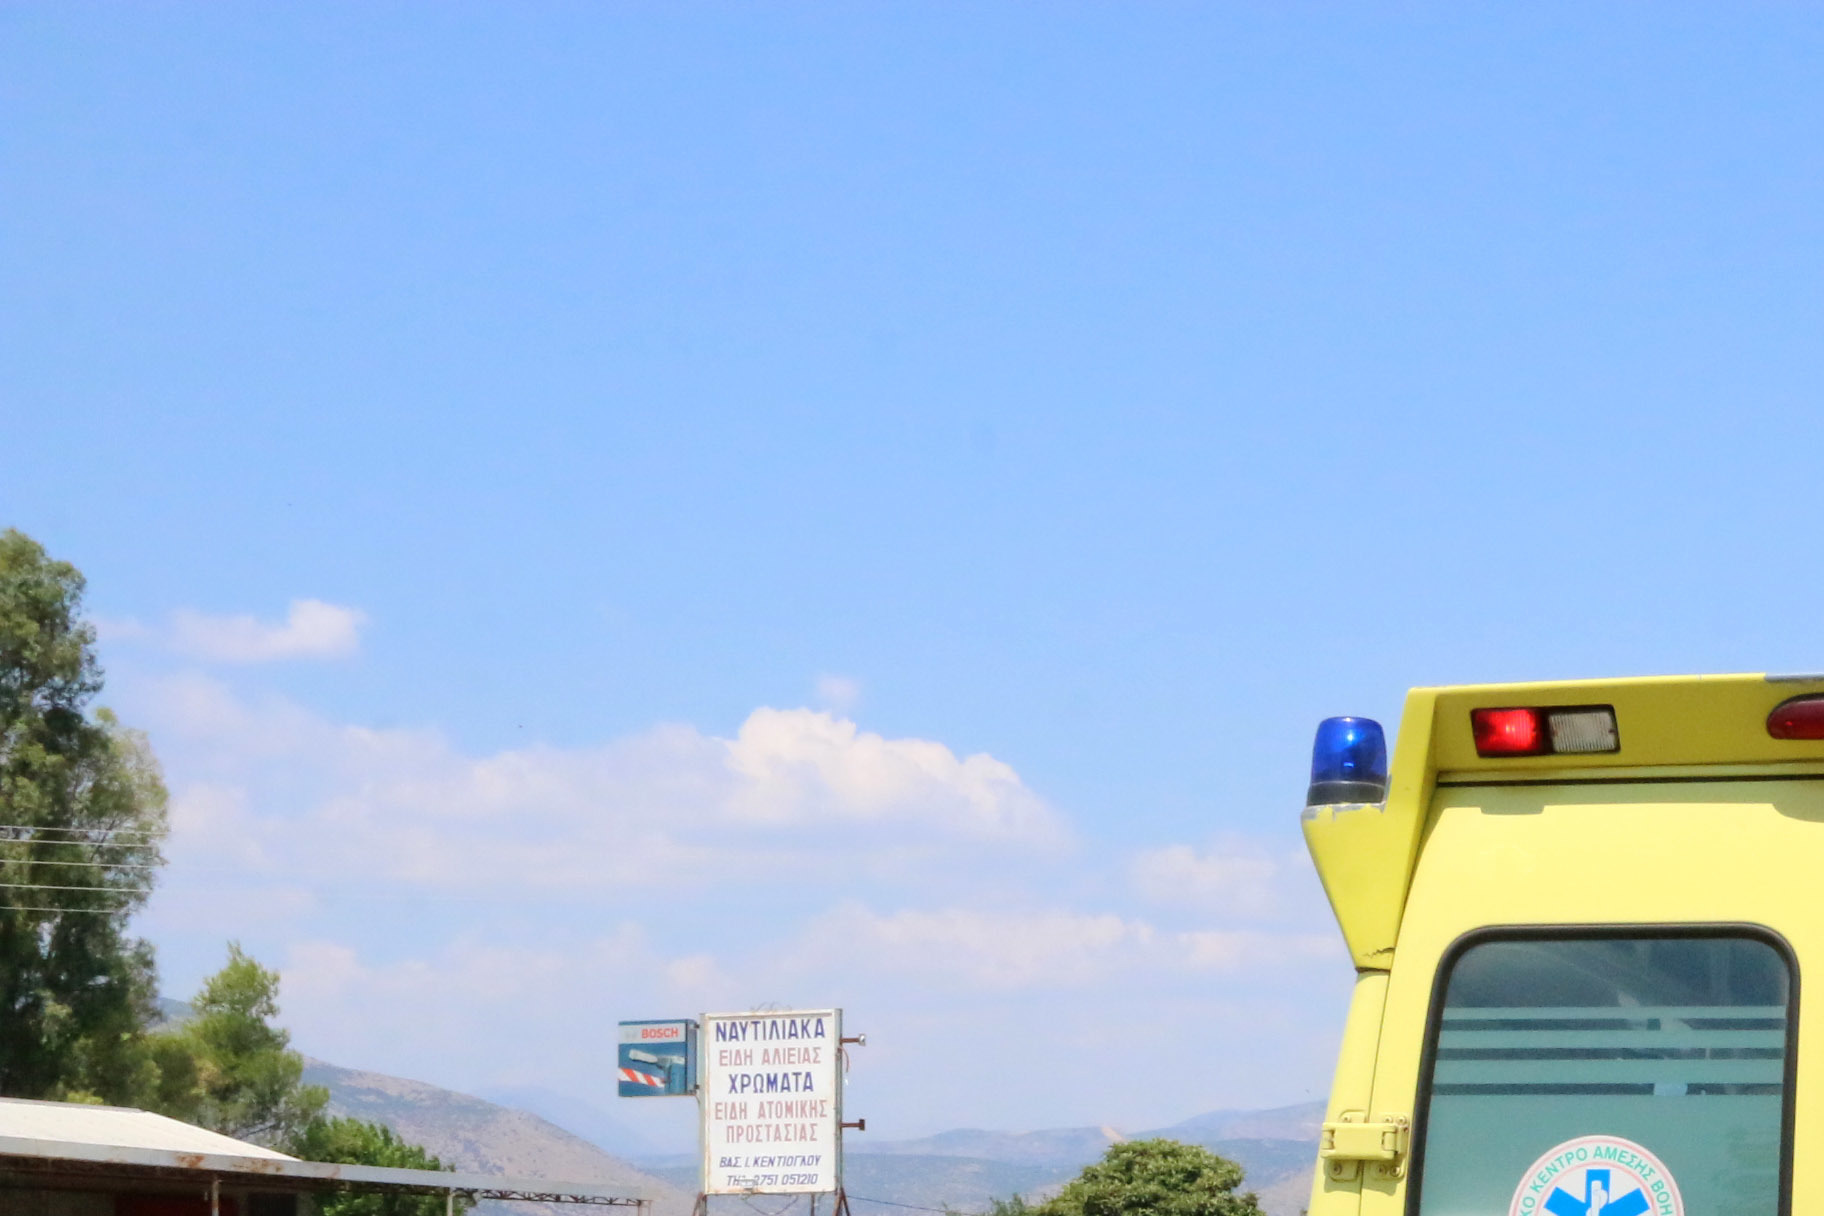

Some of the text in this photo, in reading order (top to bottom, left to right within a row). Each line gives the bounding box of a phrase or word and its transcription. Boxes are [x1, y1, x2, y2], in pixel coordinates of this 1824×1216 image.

[641, 1028, 679, 1039] BOSCH
[715, 1018, 825, 1042] ΝΑΥΤΙΛΙΑΚΑ
[719, 1047, 822, 1067] ΕΙΔΗ ΑΛΙΕΙΑΣ
[728, 1071, 814, 1094] ΧΡΩΜΑΤΑ
[714, 1099, 828, 1120] ΕΙΔΗ ΑΤΟΜΙΚΗΣ
[726, 1123, 818, 1143] ΠΡΟΣΤΑΣΙΑΣ
[1530, 1148, 1588, 1194] ΚΕΝΤΡΟ
[1593, 1145, 1656, 1181] ΑΜΕΣΗΣ
